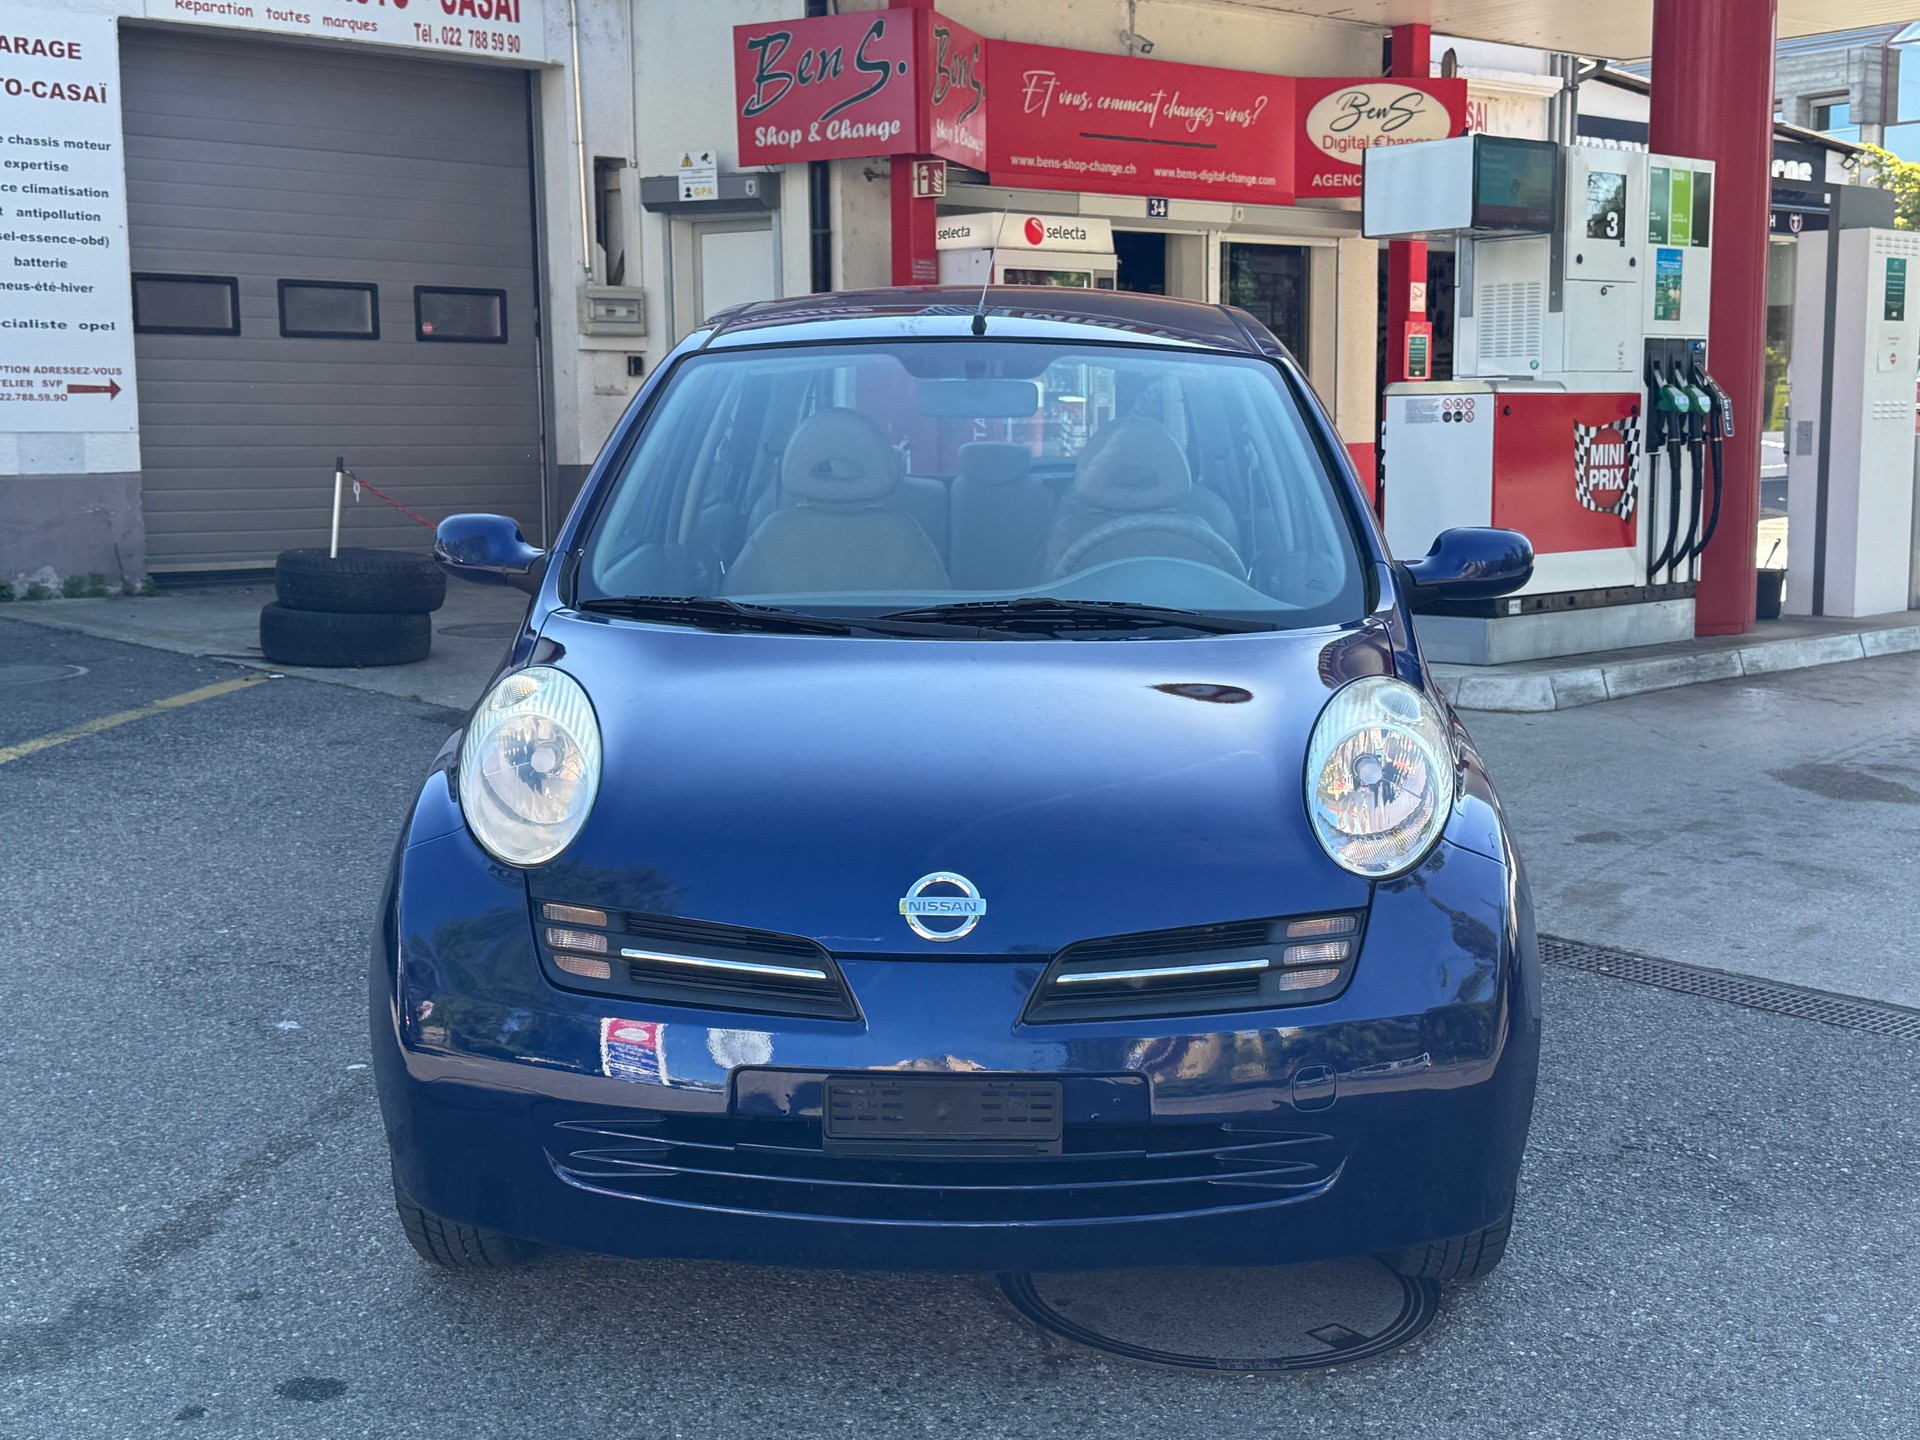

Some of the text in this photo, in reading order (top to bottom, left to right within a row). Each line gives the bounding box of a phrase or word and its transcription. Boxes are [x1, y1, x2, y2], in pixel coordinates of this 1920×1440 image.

[266, 7, 311, 24] toutes
[322, 16, 378, 33] marques
[0, 35, 82, 60] ARAGE
[441, 26, 462, 47] 022
[468, 29, 488, 50] 788
[491, 32, 504, 51] 59
[507, 34, 521, 53] 90
[932, 25, 968, 106] Ben
[742, 31, 844, 118] Ben
[1022, 70, 1060, 118] Et
[1058, 90, 1094, 111] vous,
[1097, 89, 1168, 128] comment
[7, 134, 60, 148] chassis
[63, 140, 112, 151] moteur
[755, 119, 901, 149] Shop & Change
[4, 160, 69, 172] expertise
[1010, 154, 1276, 186] www.bens-shop-change.ch www.bens-digital-change.com
[21, 183, 110, 198] climatisation
[693, 186, 714, 196] GPA
[16, 208, 101, 222] antipollution
[1151, 199, 1166, 216] 34
[1606, 211, 1618, 237] 3
[0, 231, 110, 248] el-essence-obd)
[937, 226, 971, 240] selecta
[1046, 226, 1087, 241] selecta
[13, 256, 68, 269] batterie
[78, 321, 115, 333] opel
[33, 366, 122, 376] ADRESSEZ-VOUS
[41, 379, 63, 388] SVP
[1590, 444, 1625, 466] MINI
[1589, 468, 1625, 491] PRIX
[909, 901, 977, 912] NISSAN
